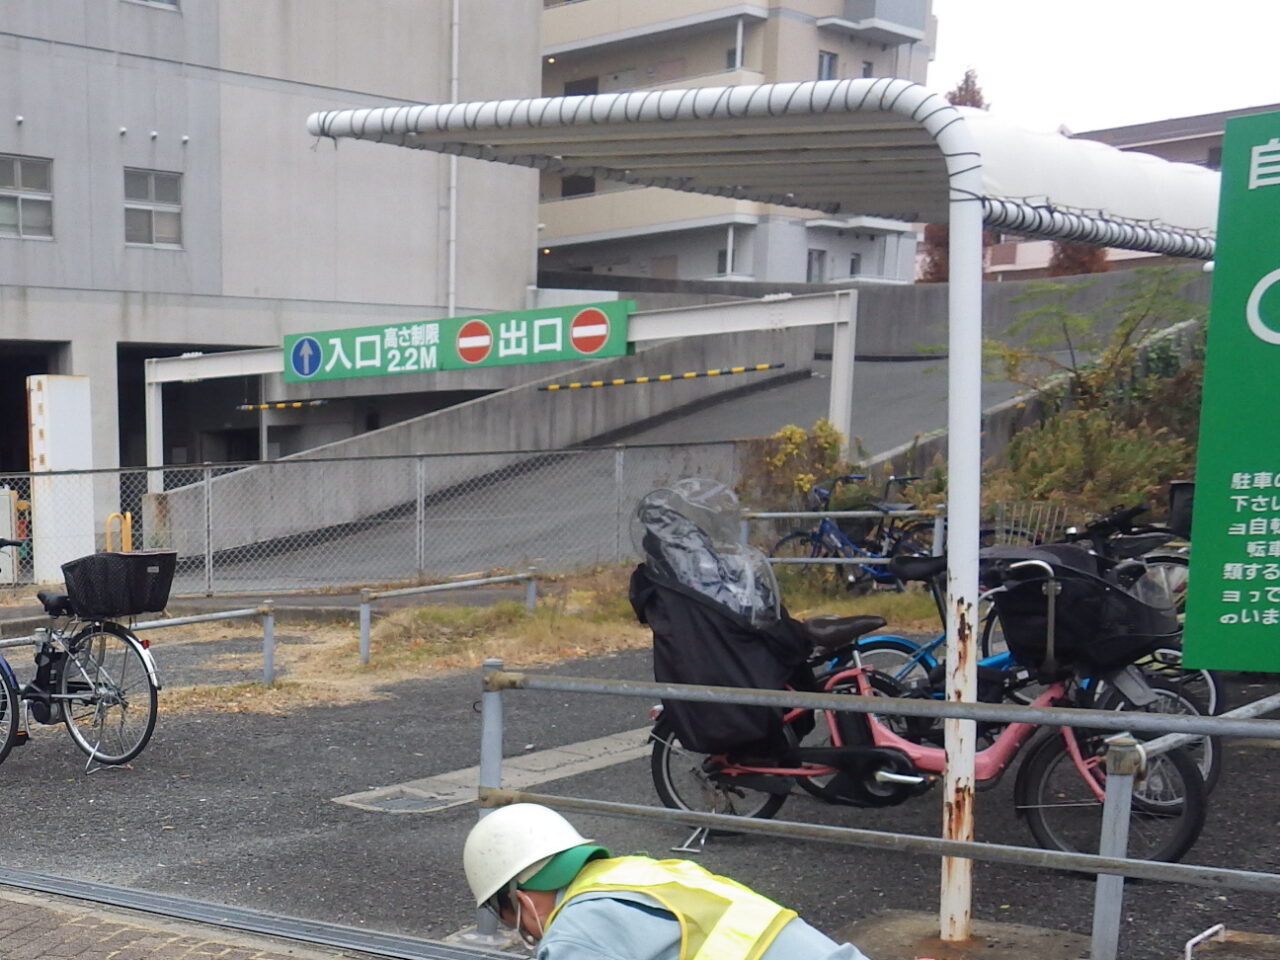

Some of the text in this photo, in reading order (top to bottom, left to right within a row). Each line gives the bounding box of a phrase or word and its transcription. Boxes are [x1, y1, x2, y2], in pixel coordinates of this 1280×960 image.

[325, 317, 563, 372] 入口 出口
[384, 324, 439, 349] 高さ制限
[387, 346, 437, 372] 2.2M
